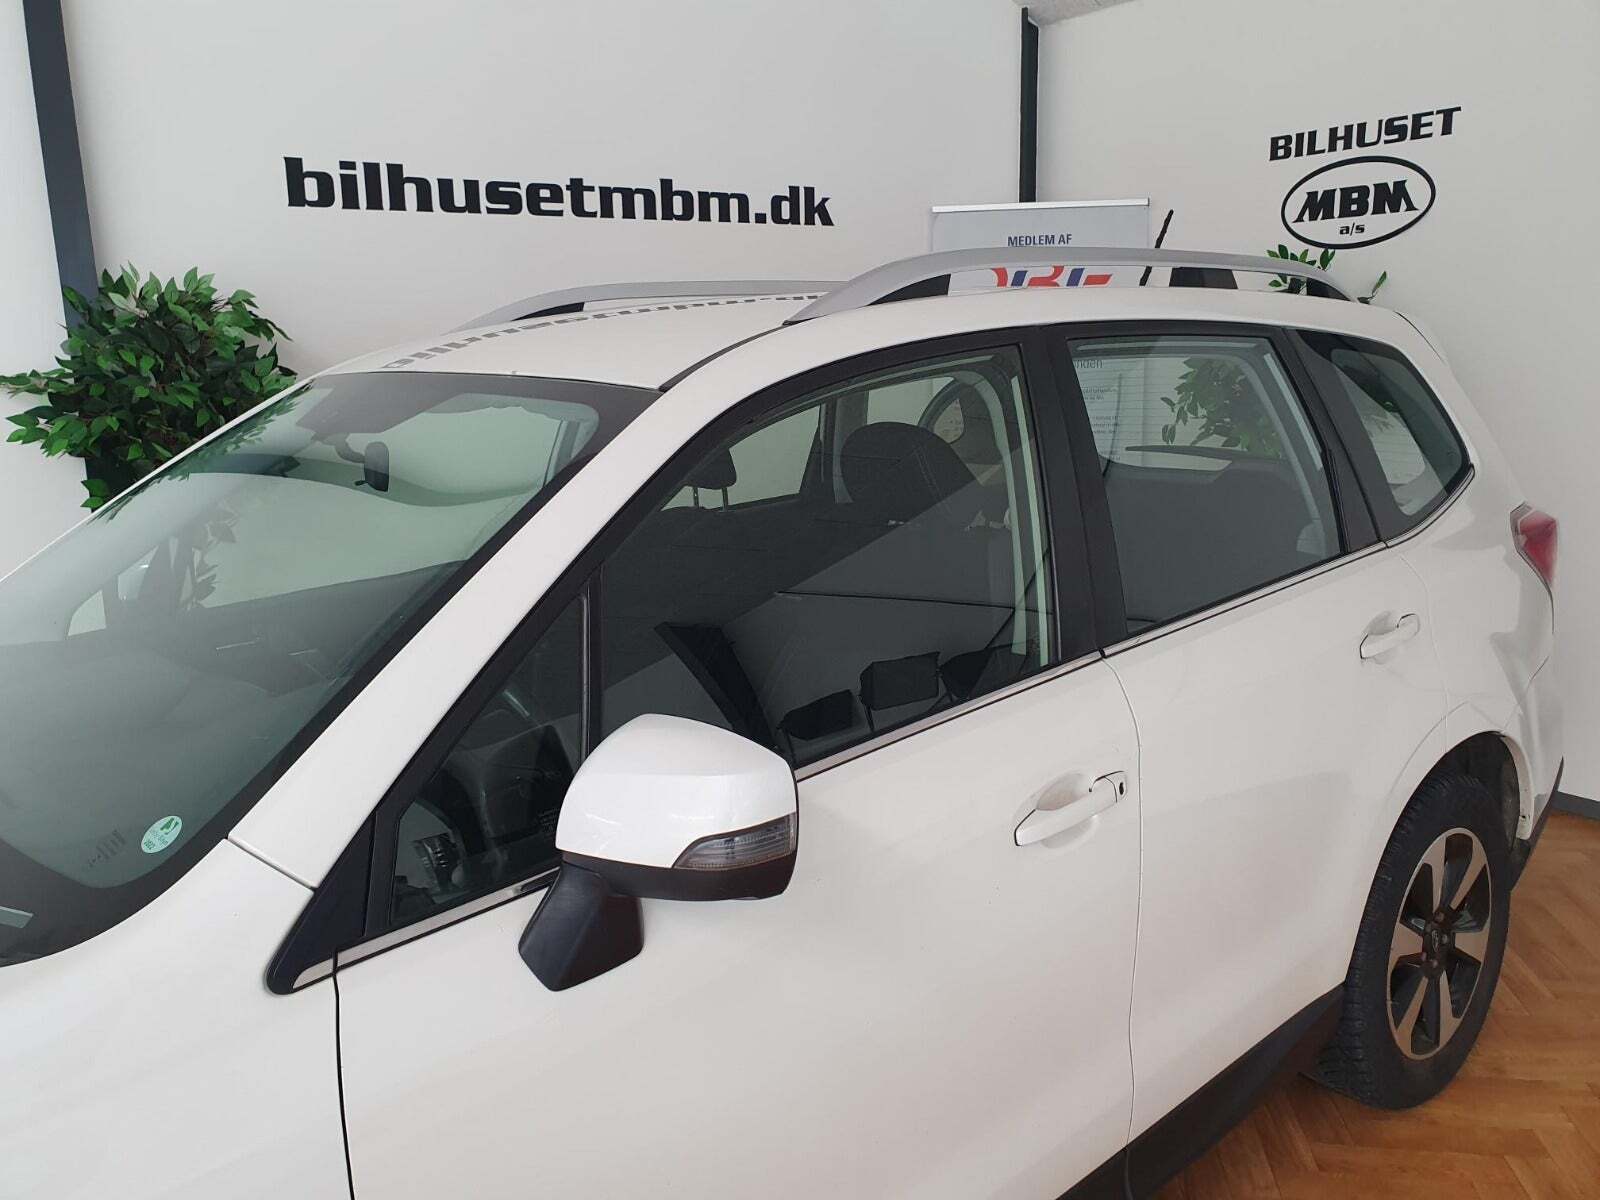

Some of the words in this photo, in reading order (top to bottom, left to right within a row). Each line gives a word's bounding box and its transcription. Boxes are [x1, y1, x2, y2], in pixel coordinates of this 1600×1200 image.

[1269, 106, 1461, 161] BILHUSET
[284, 157, 834, 226] bilhusetmbm.dk
[1292, 179, 1419, 223] MBM
[1007, 234, 1056, 247] MEDLEM
[1057, 233, 1073, 245] AF
[1339, 222, 1365, 236] a/s
